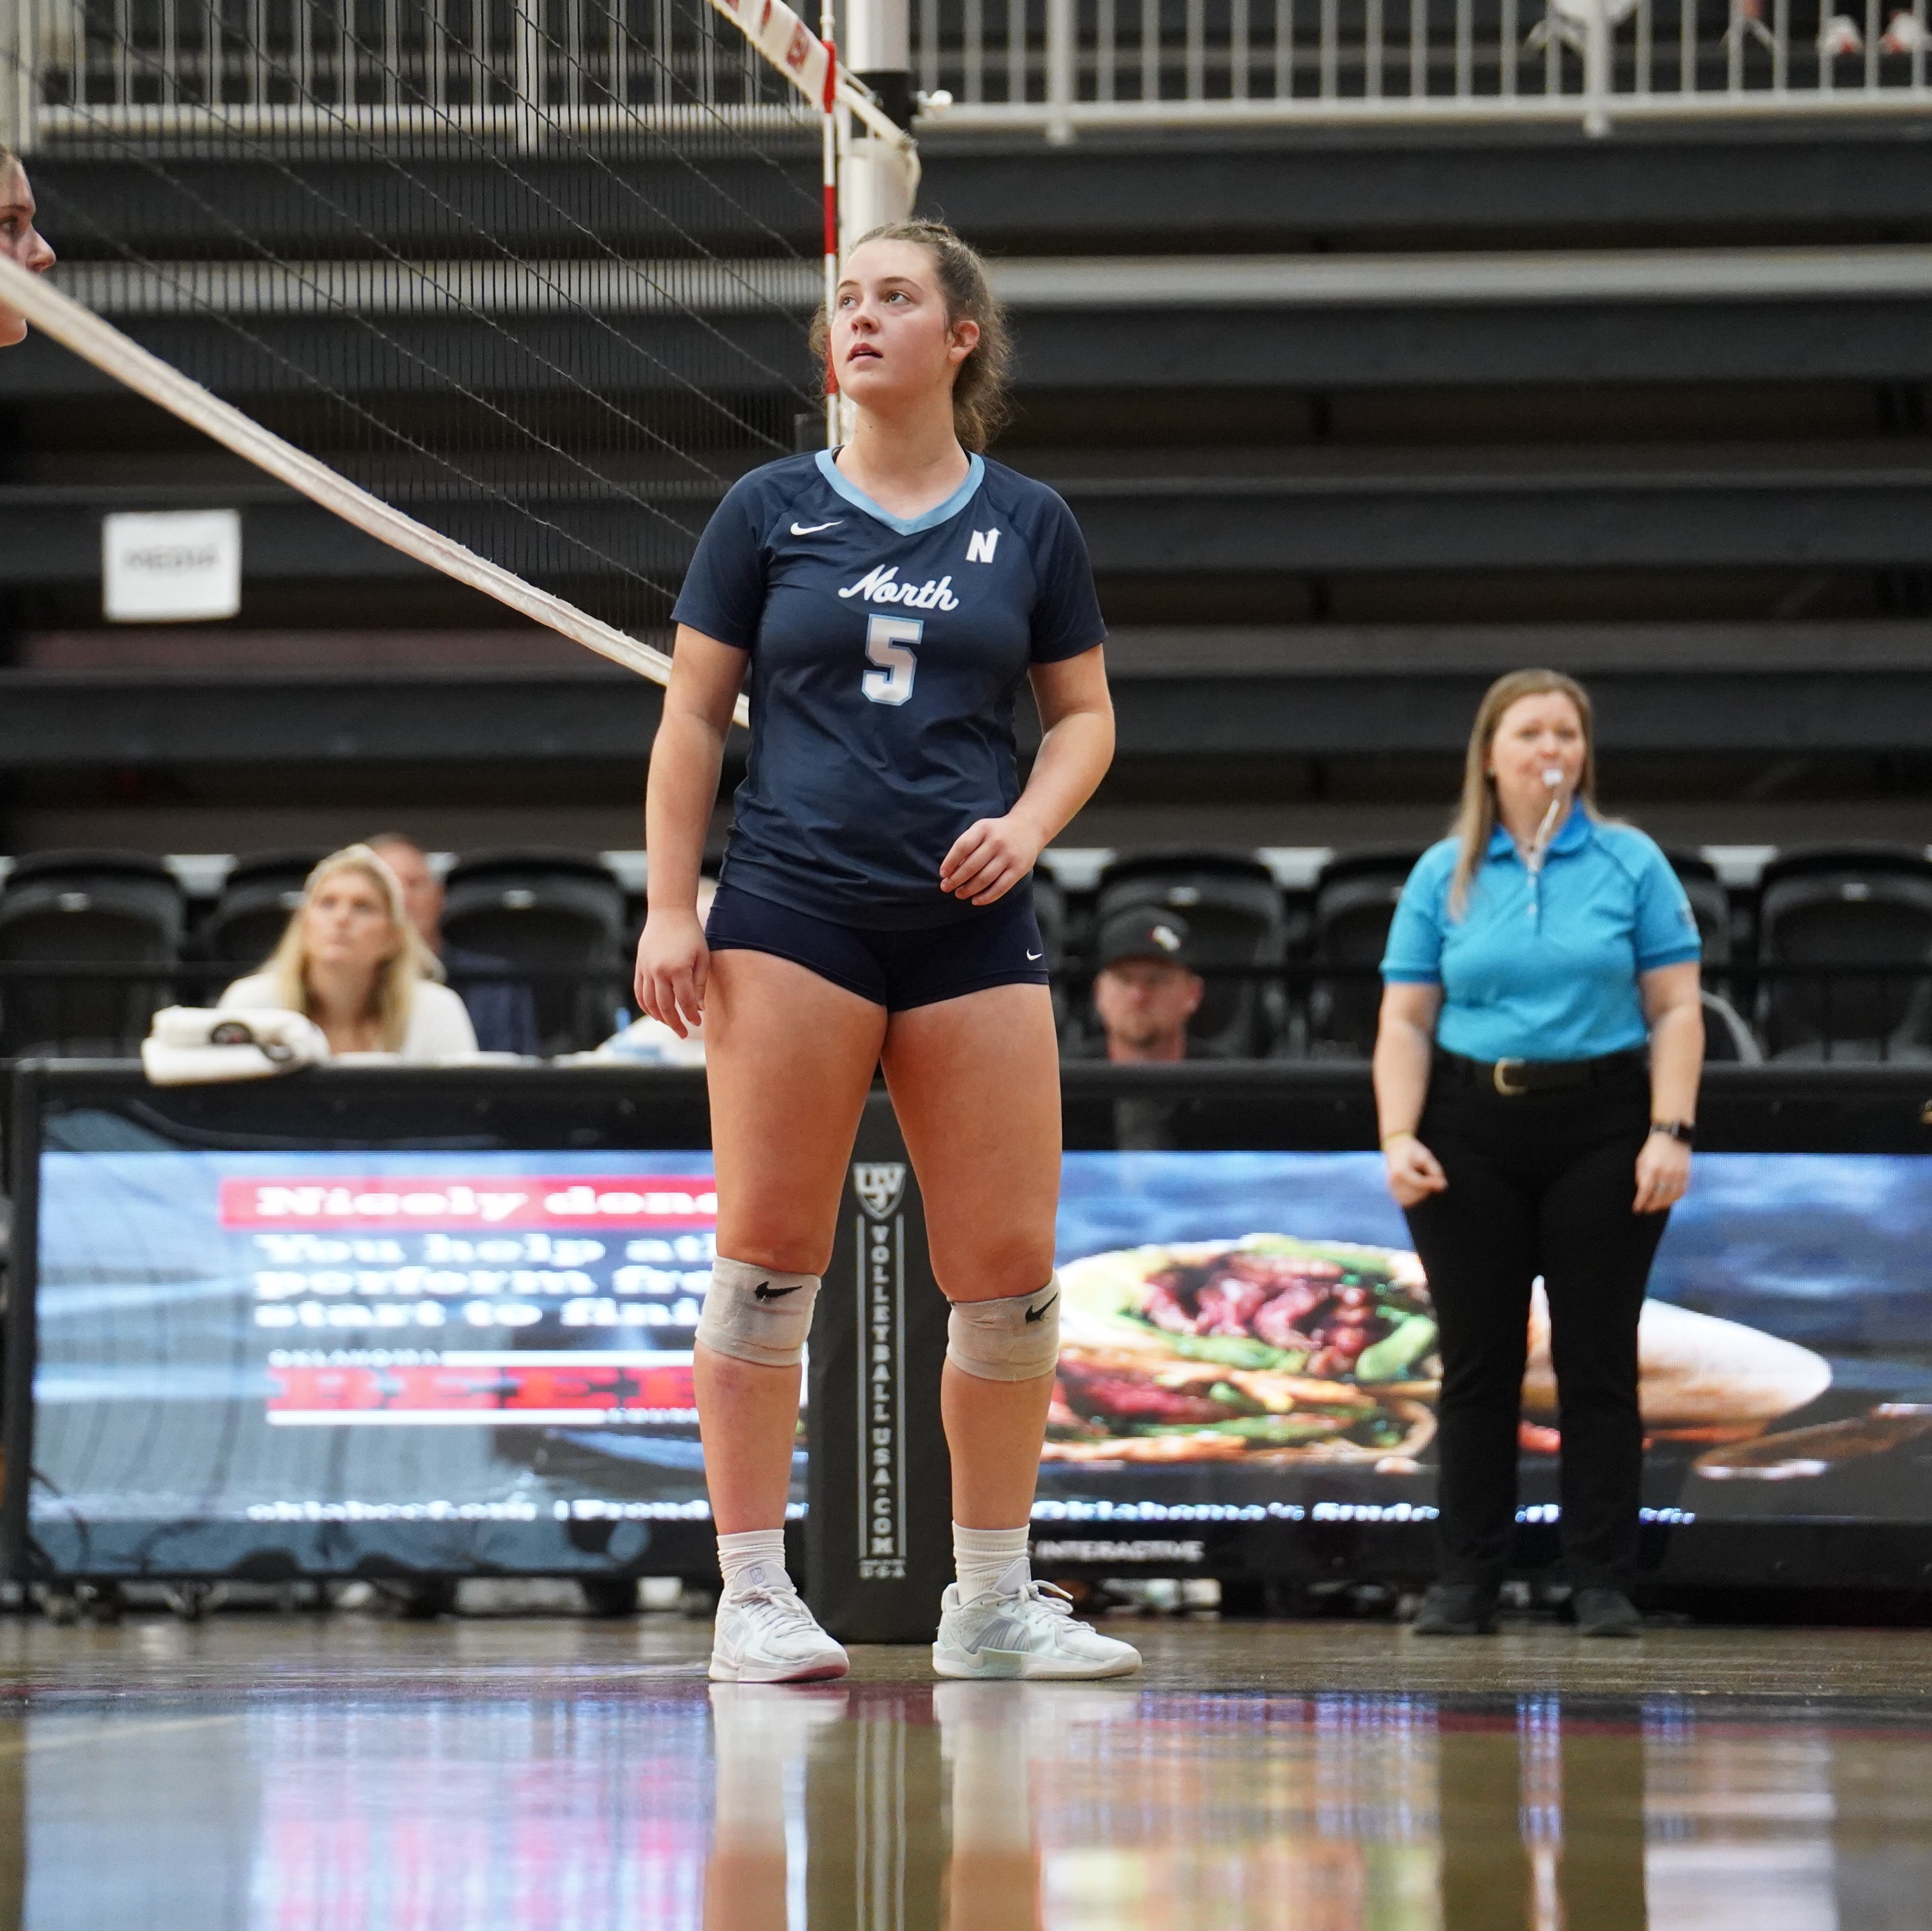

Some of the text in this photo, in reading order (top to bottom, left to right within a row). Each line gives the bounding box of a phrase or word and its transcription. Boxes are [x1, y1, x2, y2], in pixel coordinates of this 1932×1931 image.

[965, 527, 1003, 564] N
[838, 563, 959, 611] North
[861, 613, 924, 706] 5
[256, 1186, 527, 1221] Nicely
[254, 1234, 406, 1263] You
[423, 1234, 605, 1266] help
[255, 1266, 598, 1300] perform
[463, 1300, 543, 1327] to
